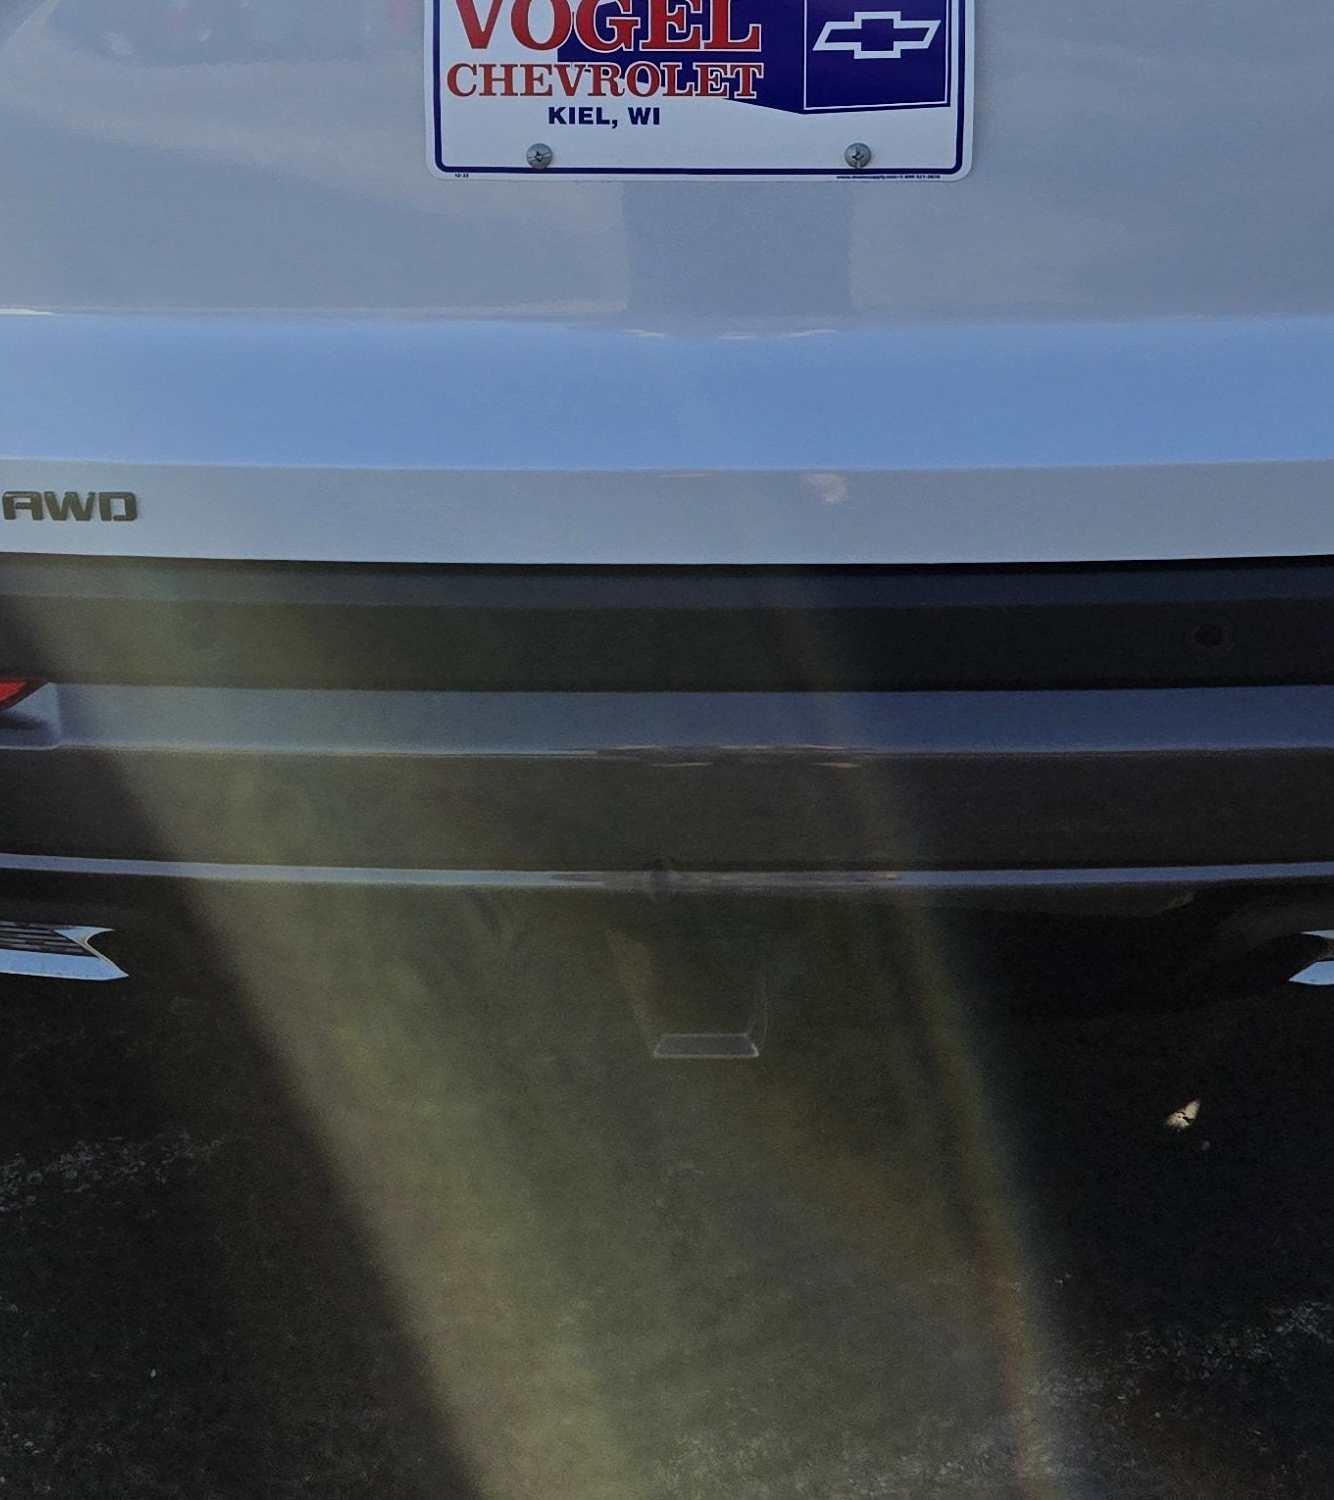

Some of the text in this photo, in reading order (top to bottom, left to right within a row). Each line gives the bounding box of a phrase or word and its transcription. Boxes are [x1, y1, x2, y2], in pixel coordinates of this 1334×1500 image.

[446, 62, 764, 99] CHEVROLET
[548, 106, 661, 129] KIEL, WI
[1, 490, 139, 522] AWD
